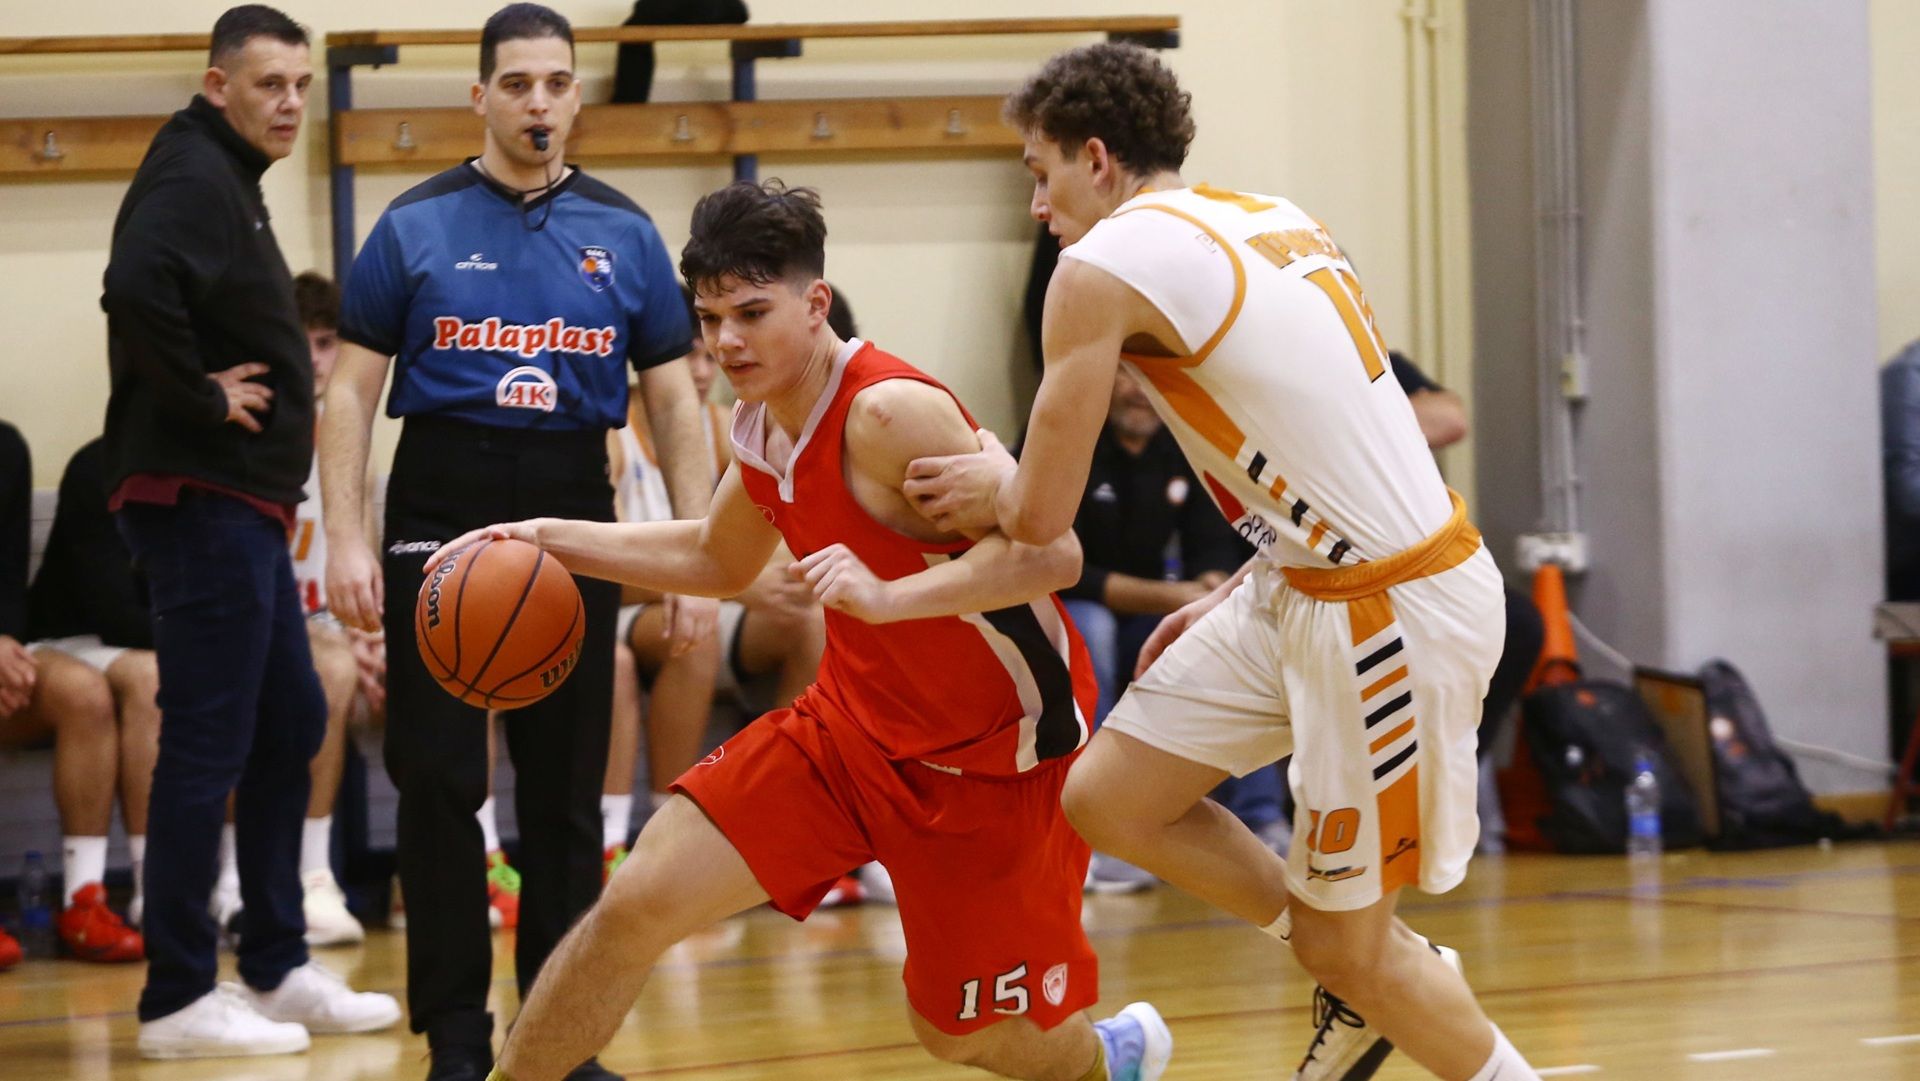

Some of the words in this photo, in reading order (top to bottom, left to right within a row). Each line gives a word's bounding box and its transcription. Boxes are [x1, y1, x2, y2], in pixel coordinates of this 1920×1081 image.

[434, 317, 616, 357] Palaplast
[503, 385, 550, 406] AK
[957, 960, 1030, 1020] 15
